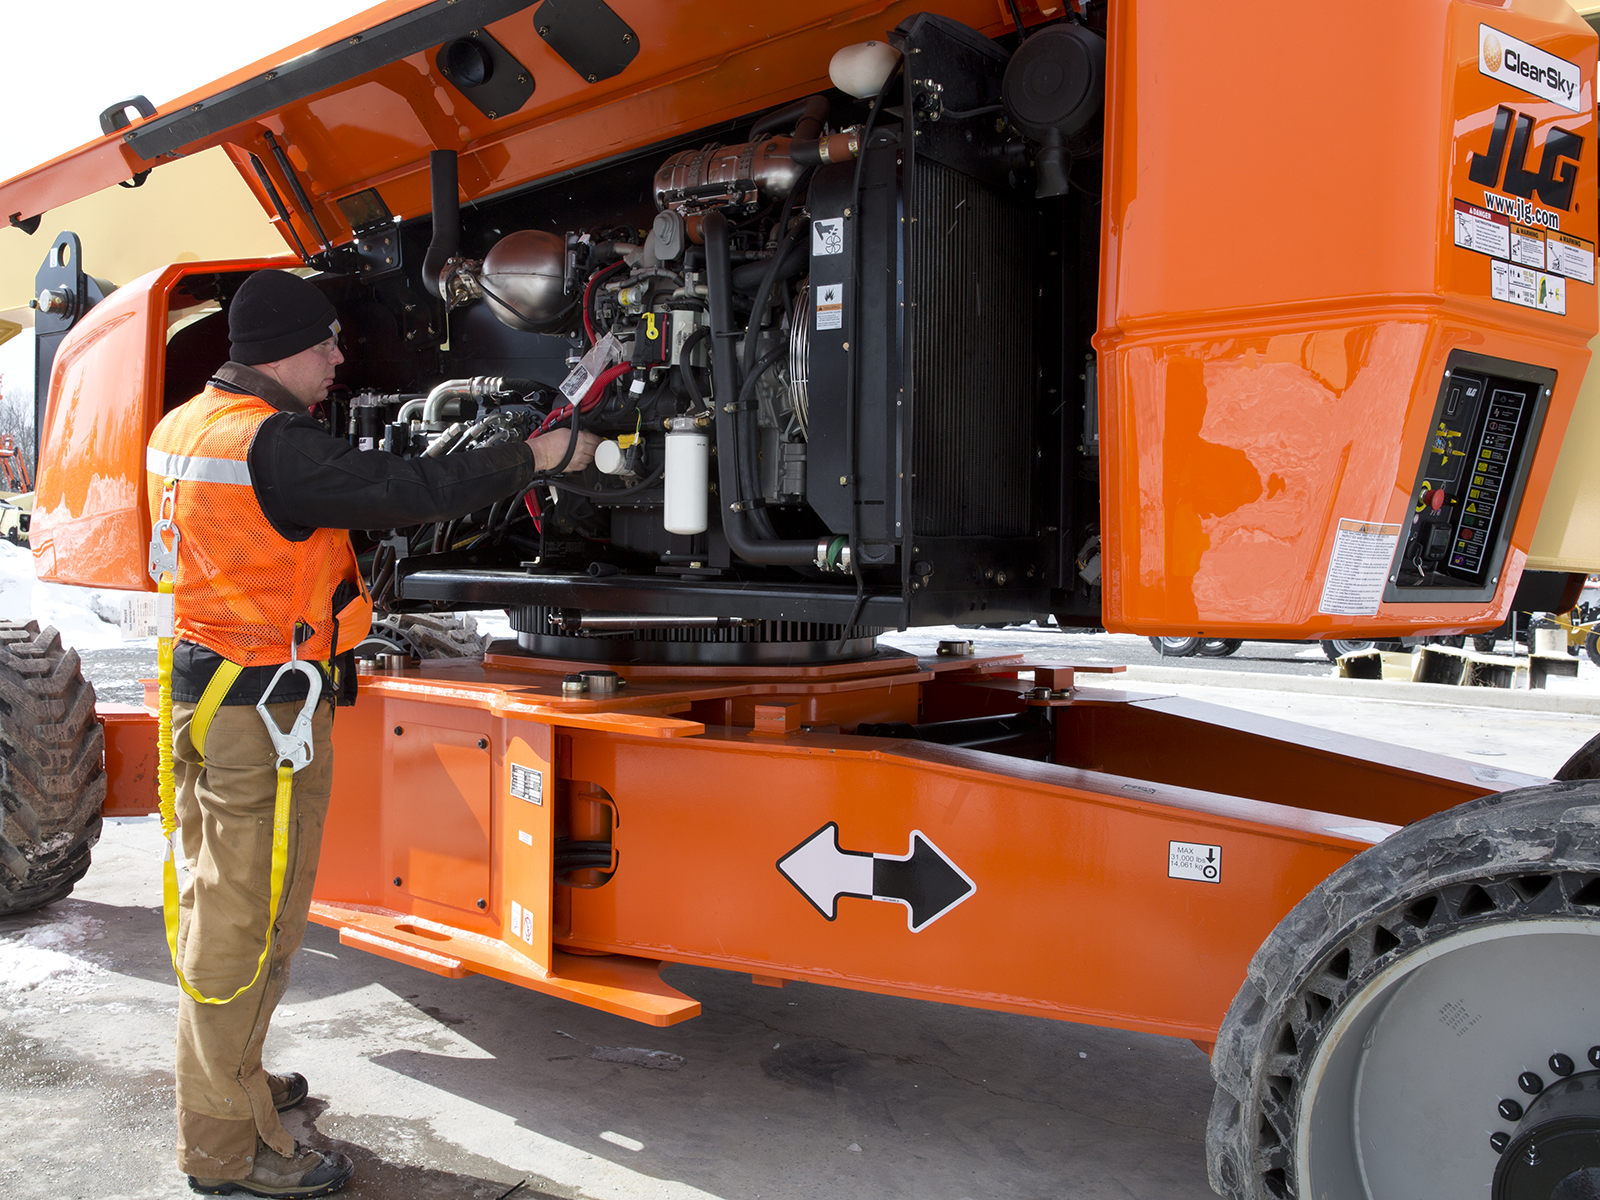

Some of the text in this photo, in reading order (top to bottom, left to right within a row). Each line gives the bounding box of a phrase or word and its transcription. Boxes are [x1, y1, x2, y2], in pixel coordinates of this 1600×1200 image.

[1504, 48, 1575, 100] ClearSky
[1468, 104, 1586, 212] JLG
[1473, 208, 1492, 220] DANGER
[1484, 192, 1559, 229] www.jlg.com
[1194, 863, 1203, 871] kg
